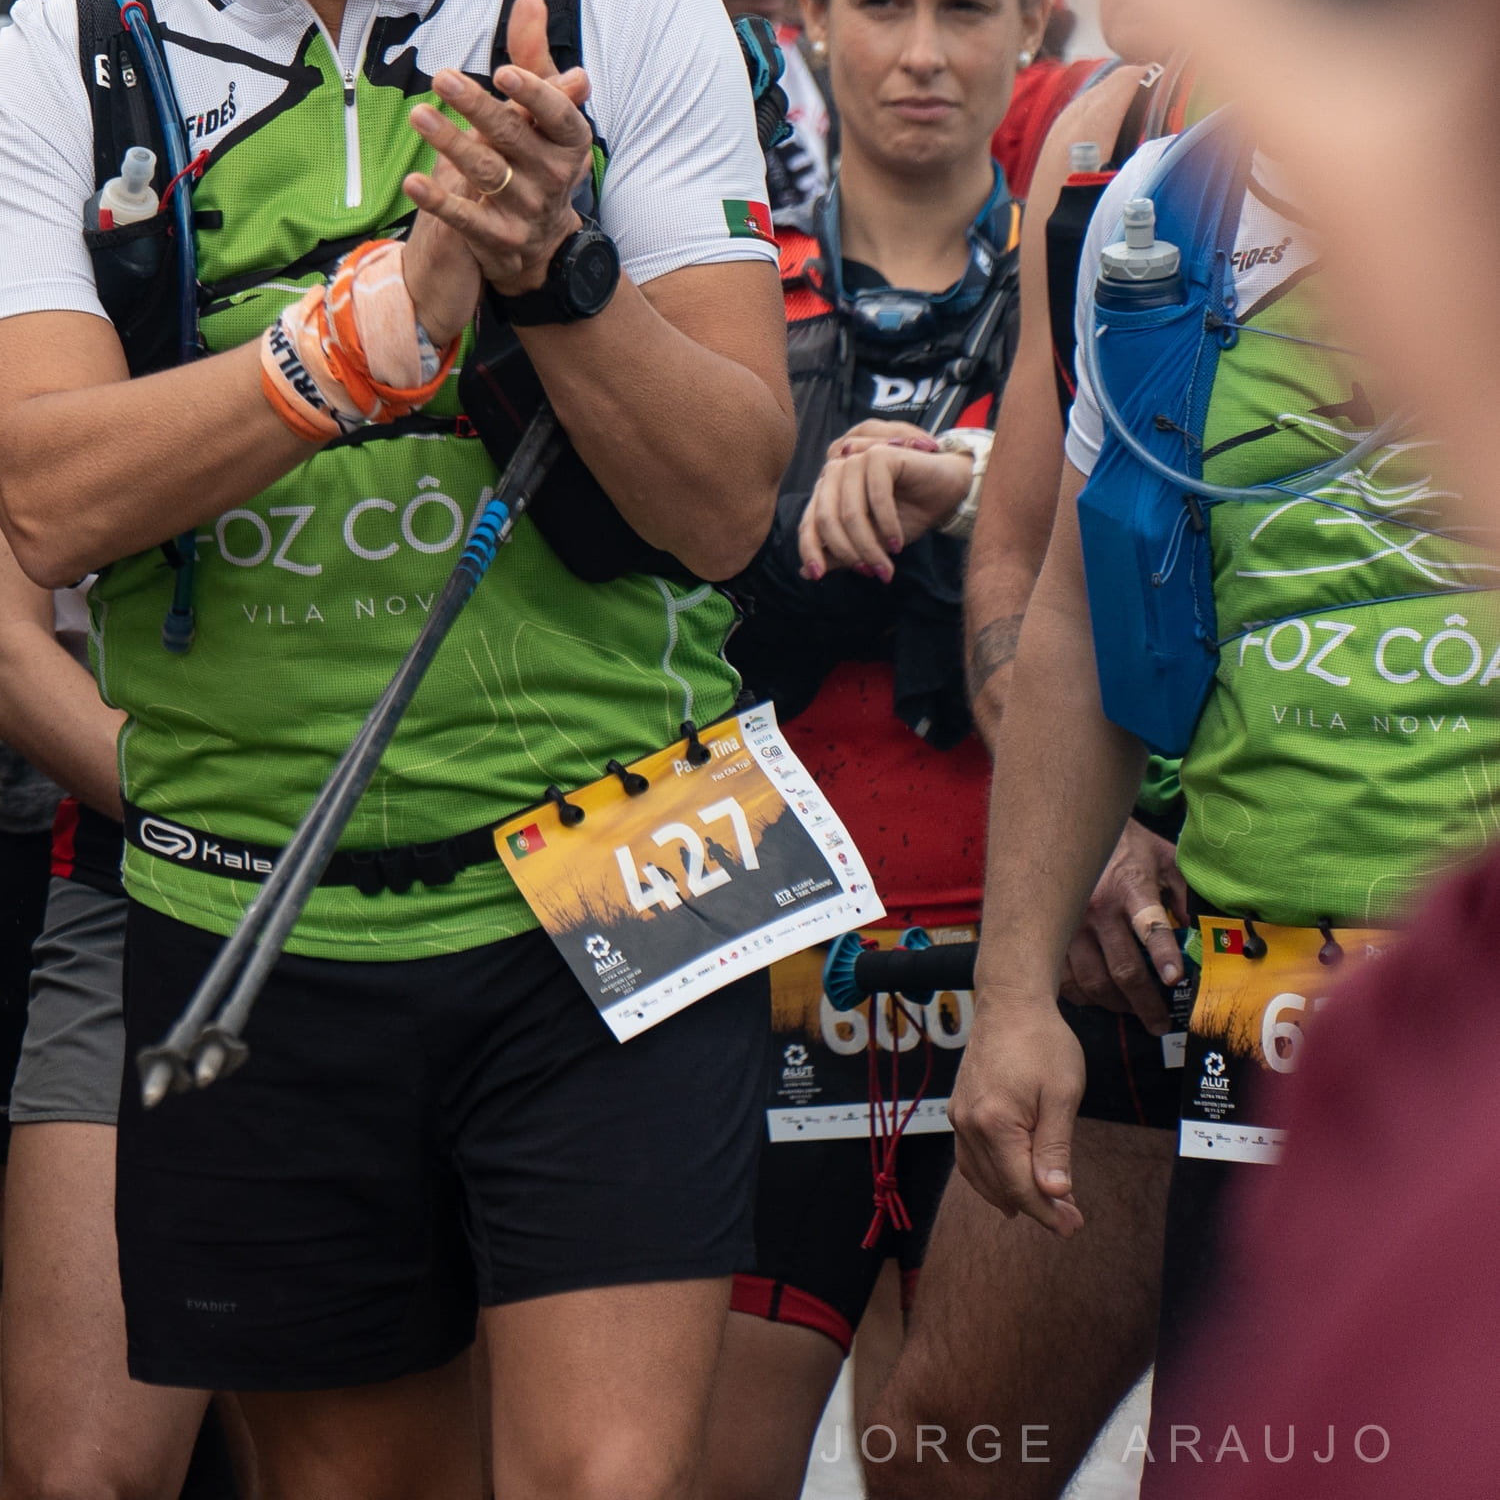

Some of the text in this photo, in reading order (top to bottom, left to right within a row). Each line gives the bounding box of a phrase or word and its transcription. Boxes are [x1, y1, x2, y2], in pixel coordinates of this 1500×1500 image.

[270, 318, 330, 410] TRILH
[241, 592, 436, 626] VILA NOV
[1270, 703, 1472, 734] VILA NOVA
[708, 736, 741, 760] Tina
[202, 840, 274, 874] Kale
[614, 796, 761, 913] 427
[594, 949, 625, 975] ALUT
[1200, 1076, 1231, 1089] ALUT
[185, 1298, 239, 1314] EVADICT
